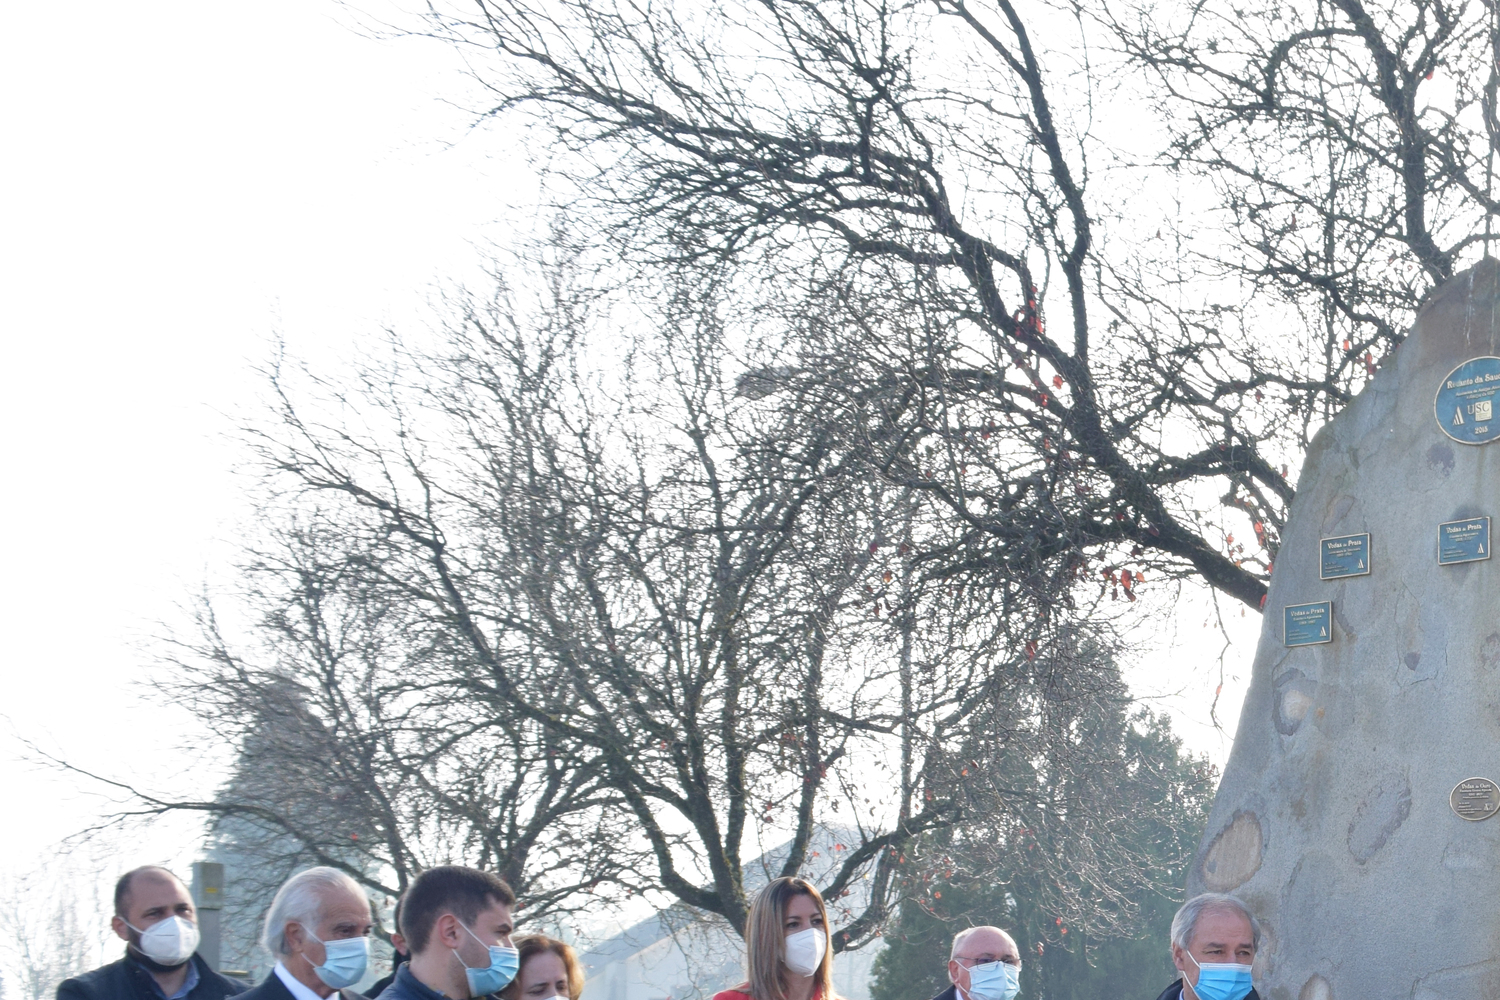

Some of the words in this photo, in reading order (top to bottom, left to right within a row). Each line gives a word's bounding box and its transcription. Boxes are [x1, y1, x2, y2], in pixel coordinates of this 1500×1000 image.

[1475, 376, 1483, 384] da
[1467, 402, 1490, 415] USC
[1475, 426, 1488, 434] 2015
